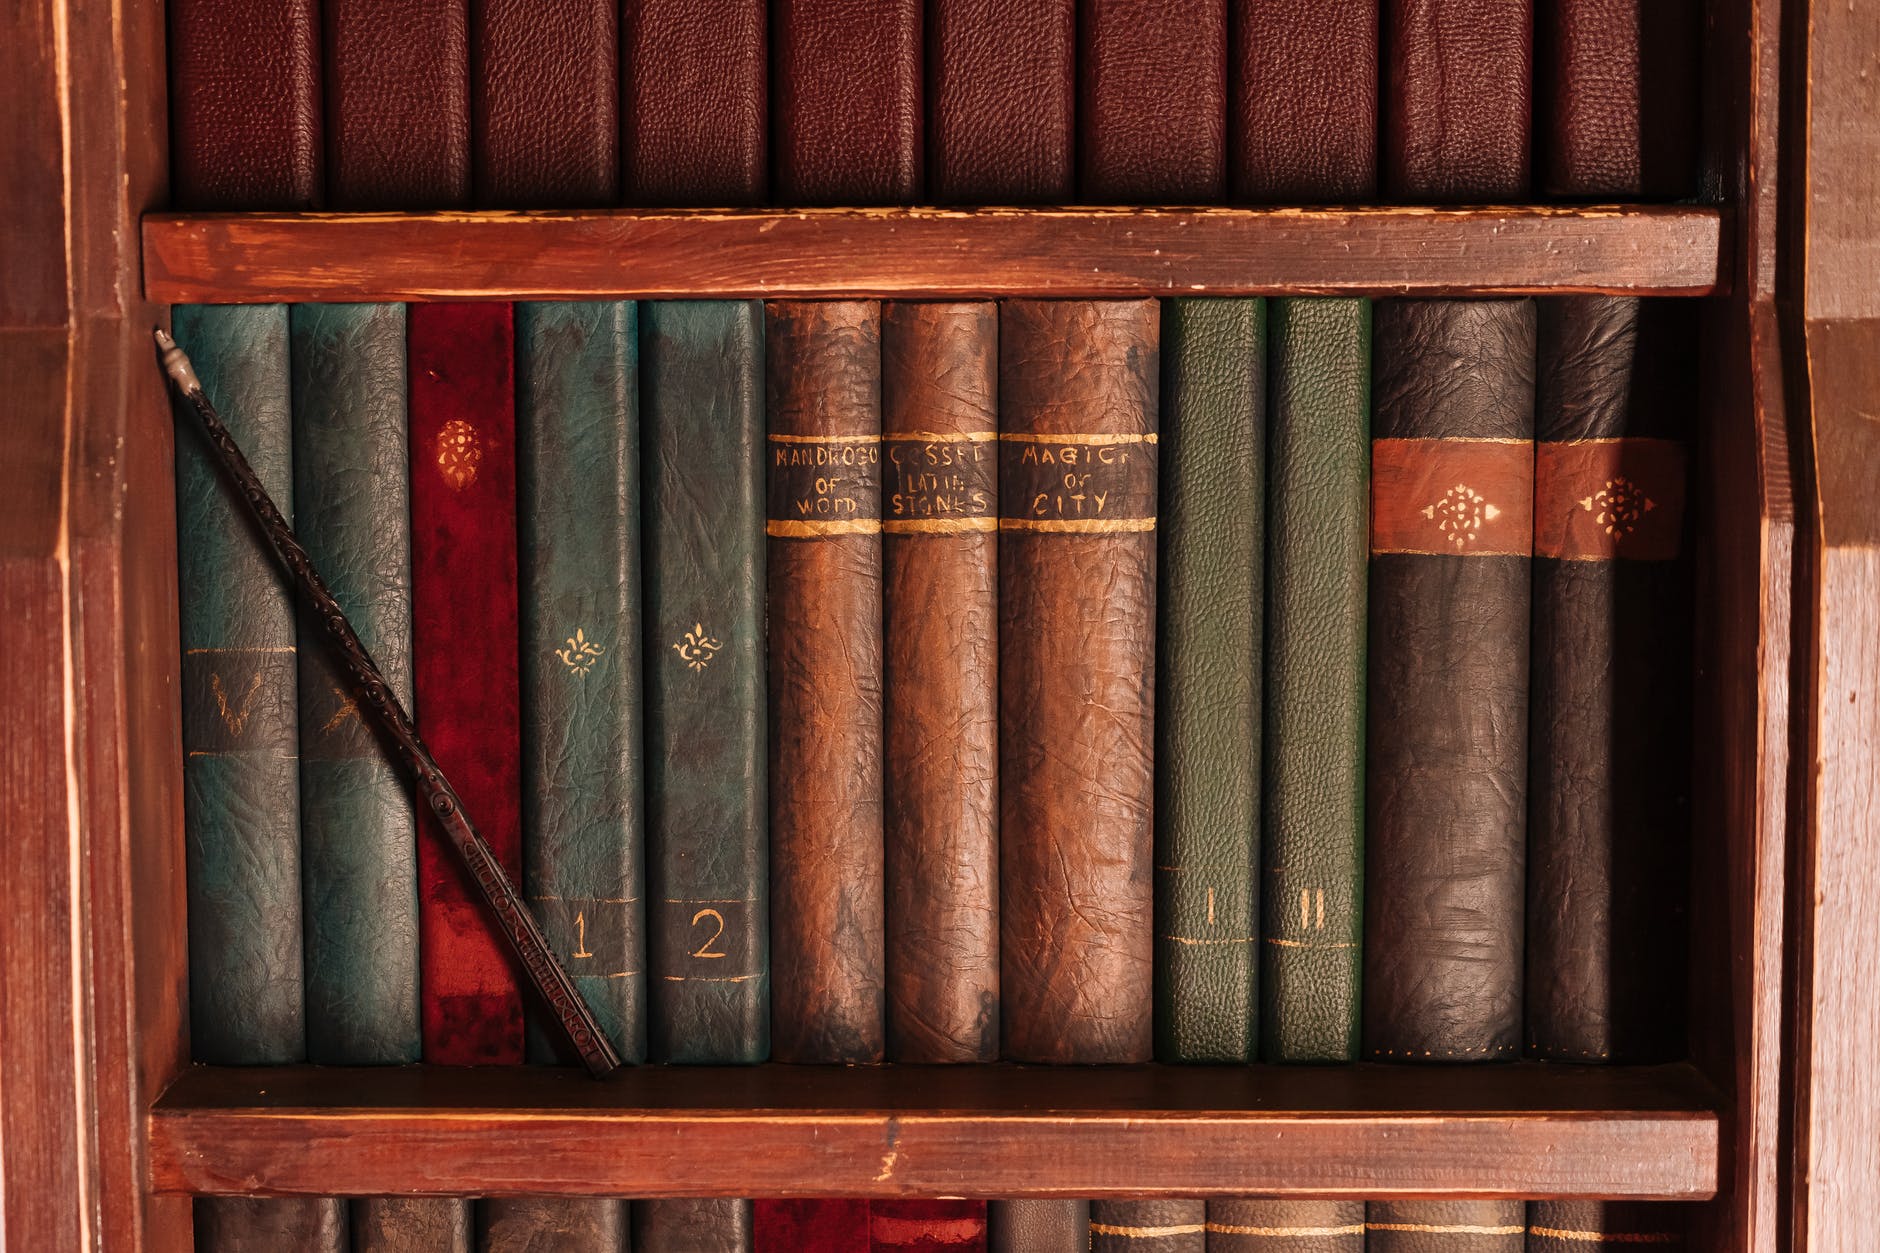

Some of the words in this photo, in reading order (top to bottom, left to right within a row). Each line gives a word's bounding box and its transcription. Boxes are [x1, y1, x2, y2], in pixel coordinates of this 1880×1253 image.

[816, 477, 841, 495] OF
[1032, 490, 1108, 516] CITY
[572, 911, 594, 959] 1
[691, 908, 727, 958] 2
